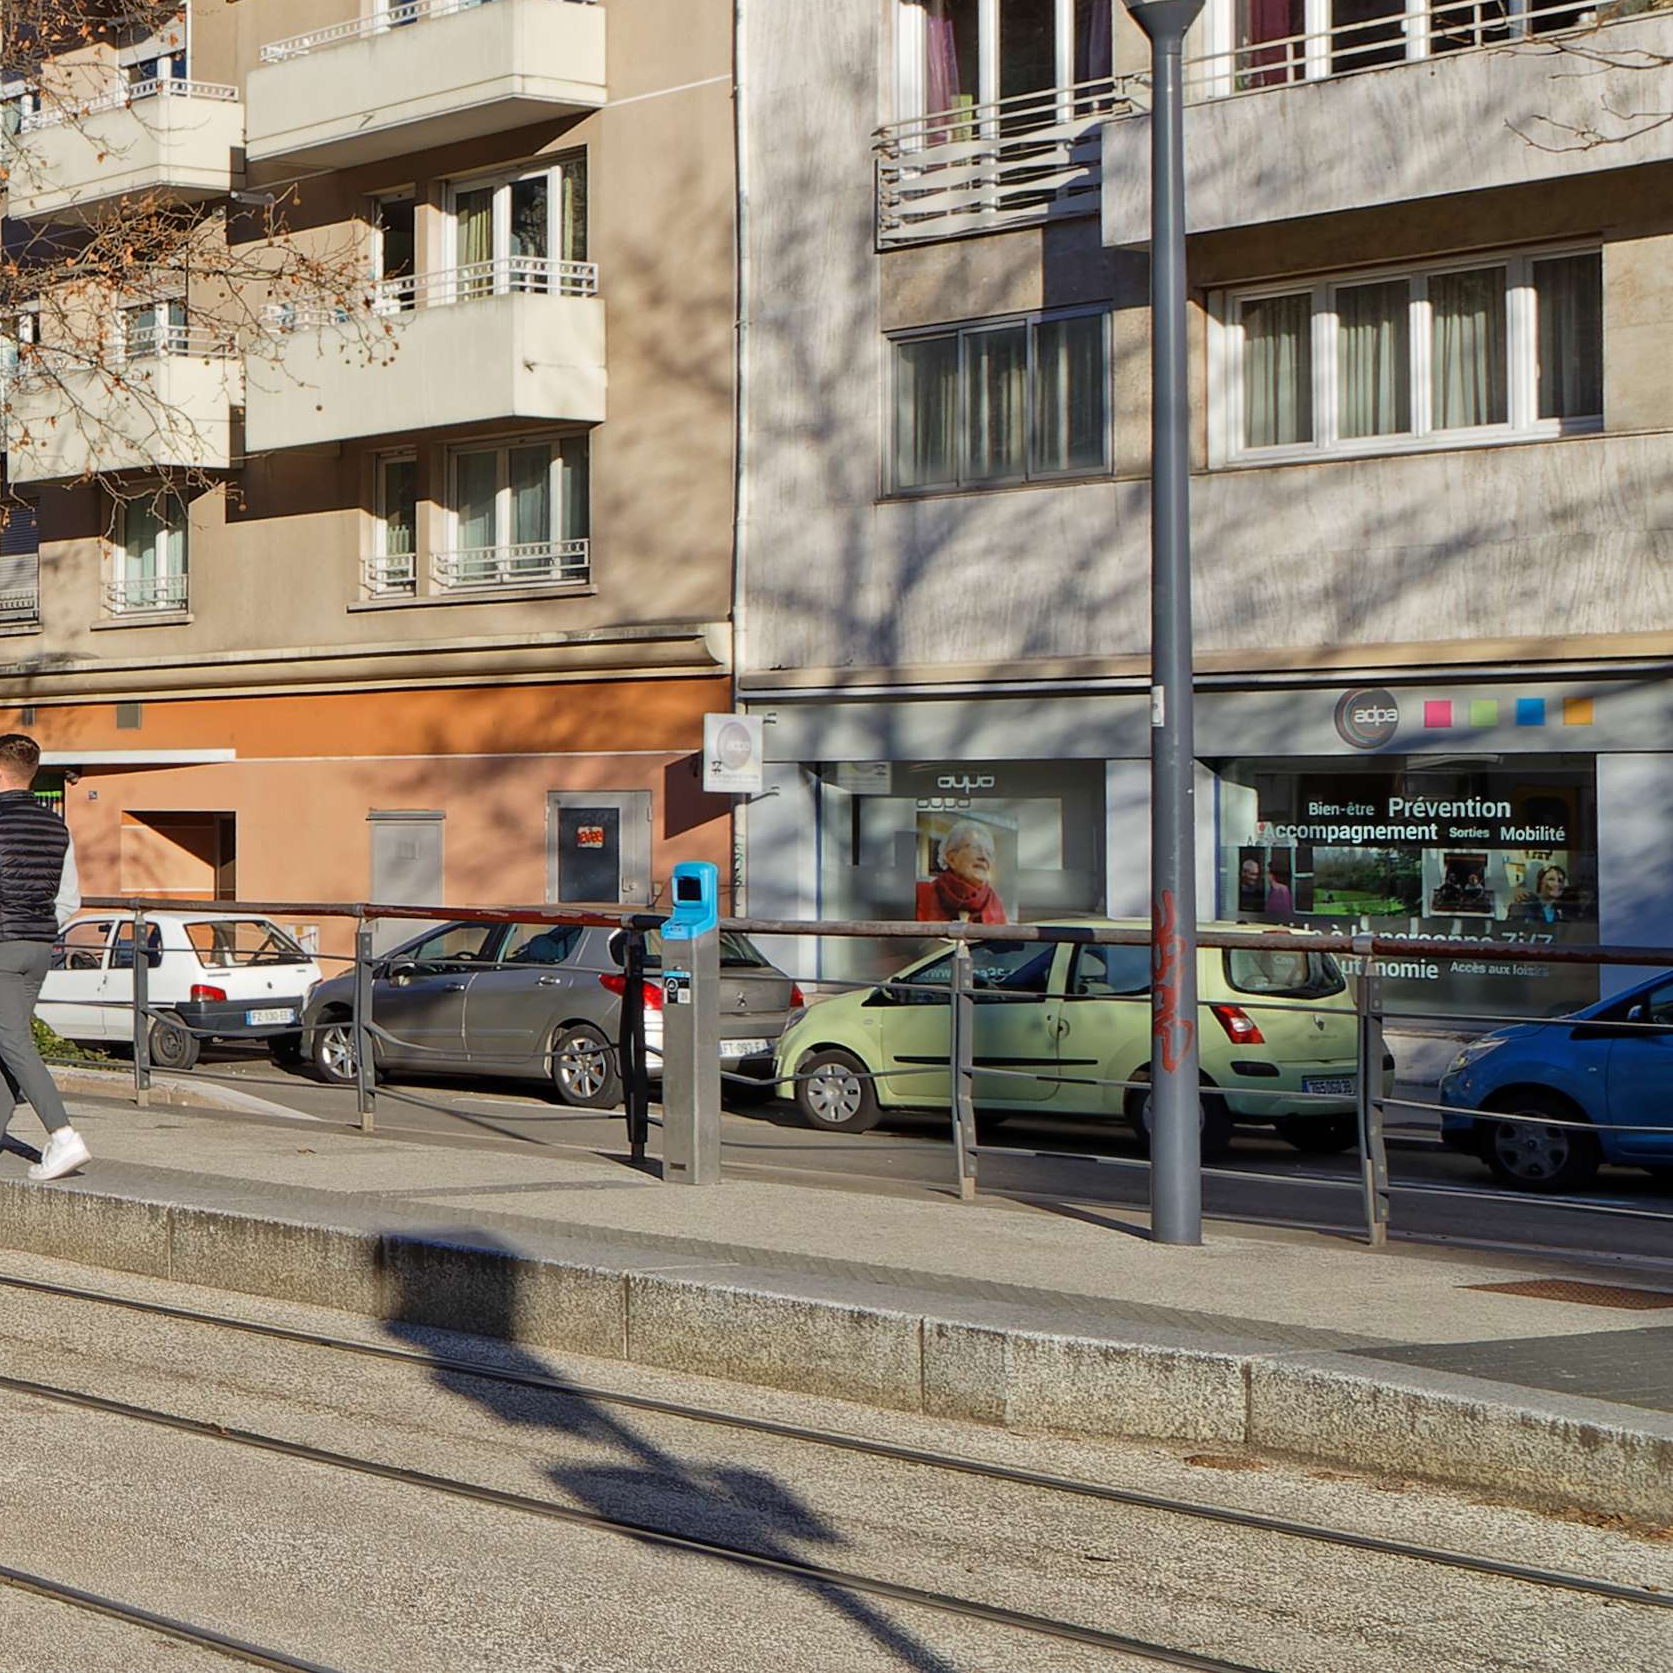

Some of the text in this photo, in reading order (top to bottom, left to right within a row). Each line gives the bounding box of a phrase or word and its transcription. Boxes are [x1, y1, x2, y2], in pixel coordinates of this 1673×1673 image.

[1354, 705, 1398, 726] adpa
[1308, 796, 1511, 818] Bien-être Prévention
[1263, 823, 1439, 843] Accompagnement
[1449, 826, 1491, 838] Sorties
[1500, 825, 1566, 841] Mobilité
[1340, 958, 1440, 979] utnomie
[1450, 961, 1486, 974] Accès
[1488, 965, 1510, 975] aux
